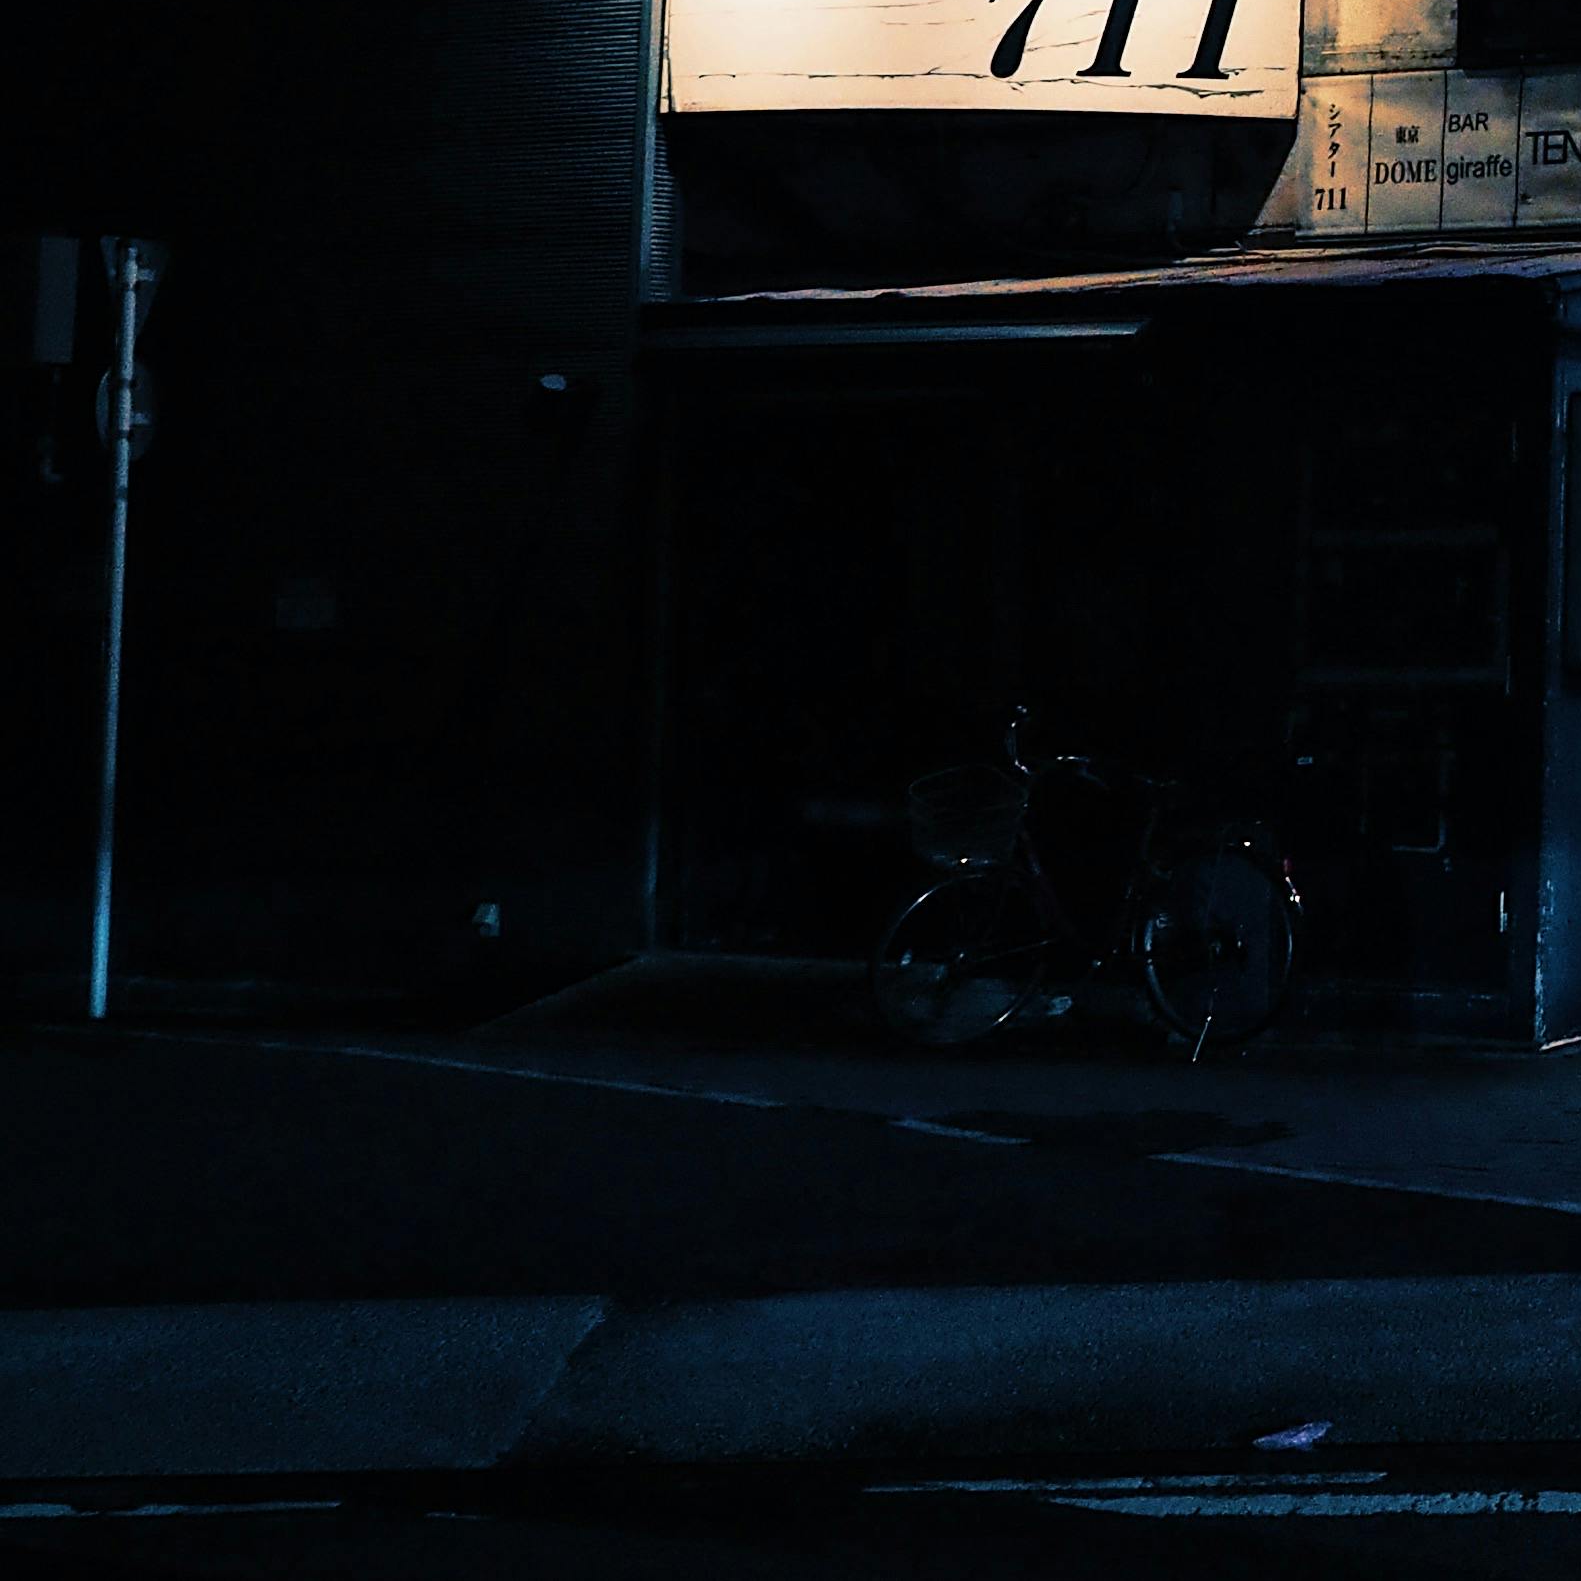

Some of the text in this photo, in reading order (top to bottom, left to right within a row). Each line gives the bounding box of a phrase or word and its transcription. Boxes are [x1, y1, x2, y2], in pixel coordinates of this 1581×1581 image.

[1447, 112, 1489, 133] BAR
[1327, 103, 1341, 178] シアター
[1374, 159, 1437, 185] DOME
[1446, 154, 1513, 185] giraffe
[1315, 186, 1347, 211] 711
